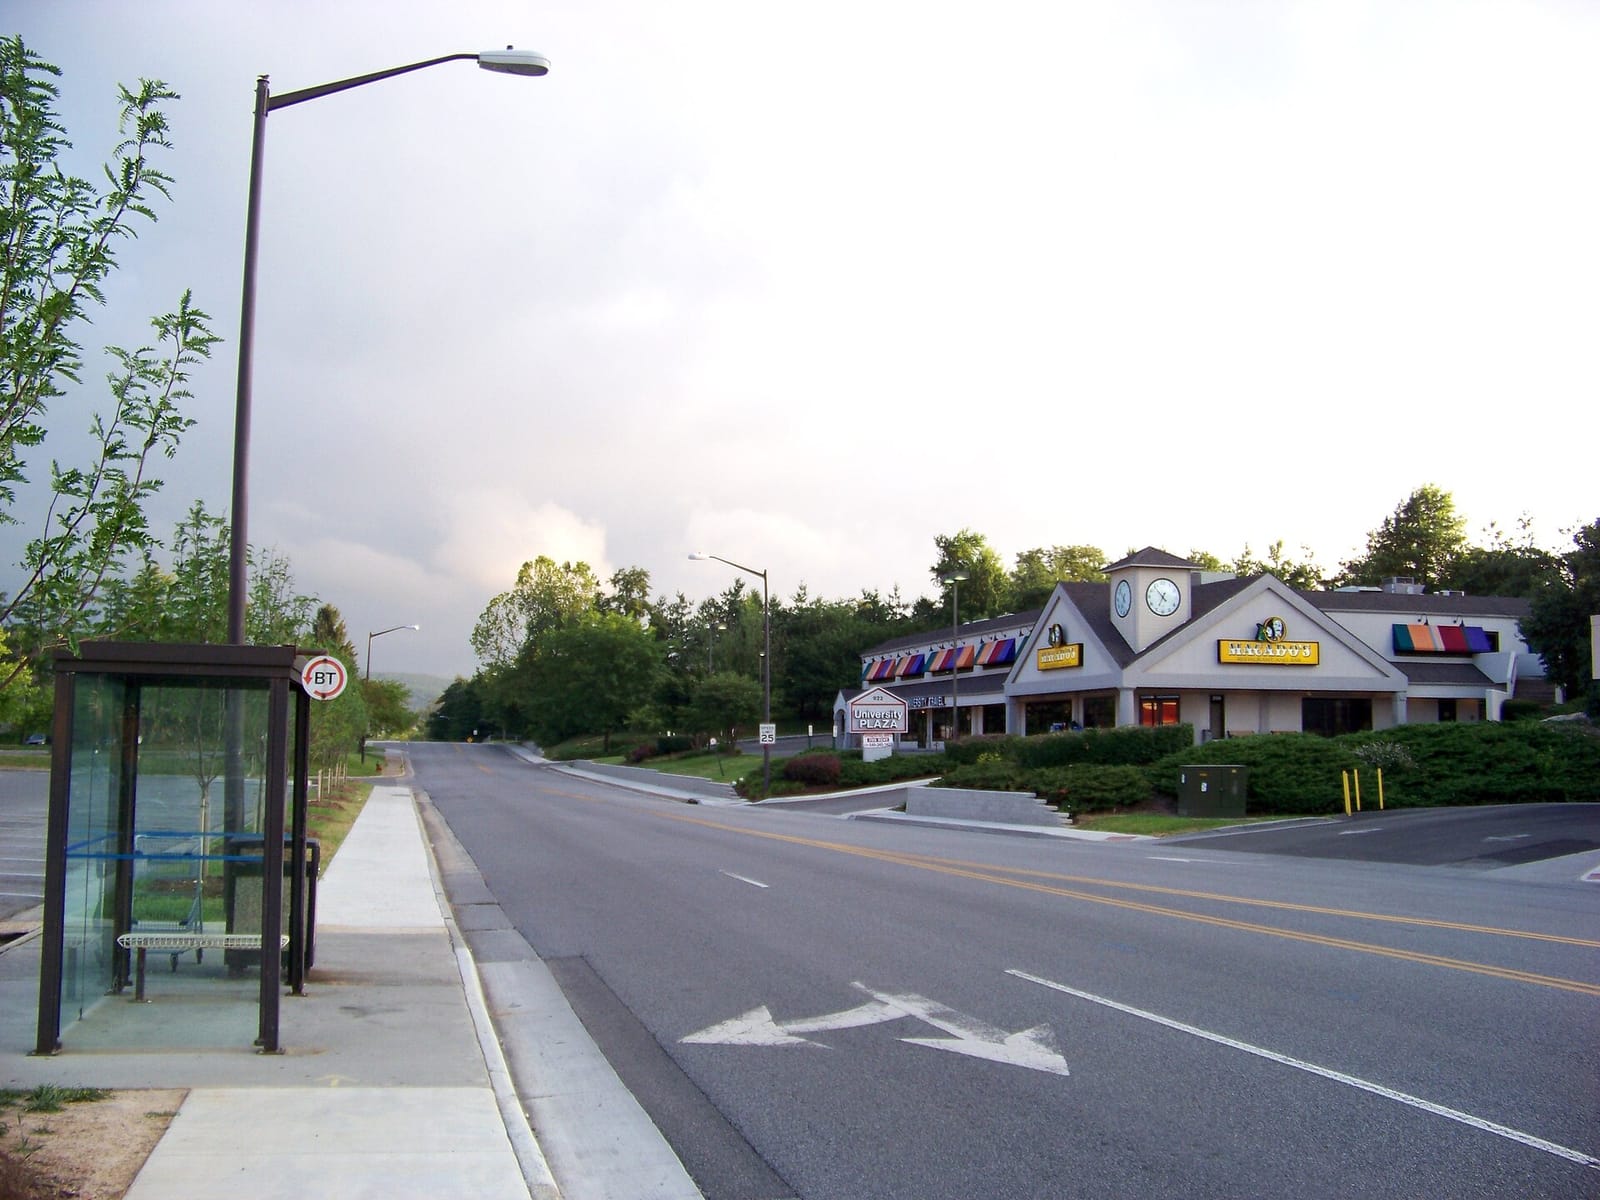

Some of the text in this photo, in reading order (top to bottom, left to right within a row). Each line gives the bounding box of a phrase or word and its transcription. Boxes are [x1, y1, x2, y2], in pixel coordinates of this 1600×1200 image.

[1229, 642, 1311, 657] MACADO'S
[314, 671, 337, 685] BT
[854, 709, 903, 720] University
[859, 719, 898, 729] PLAZA
[761, 734, 774, 742] 25
